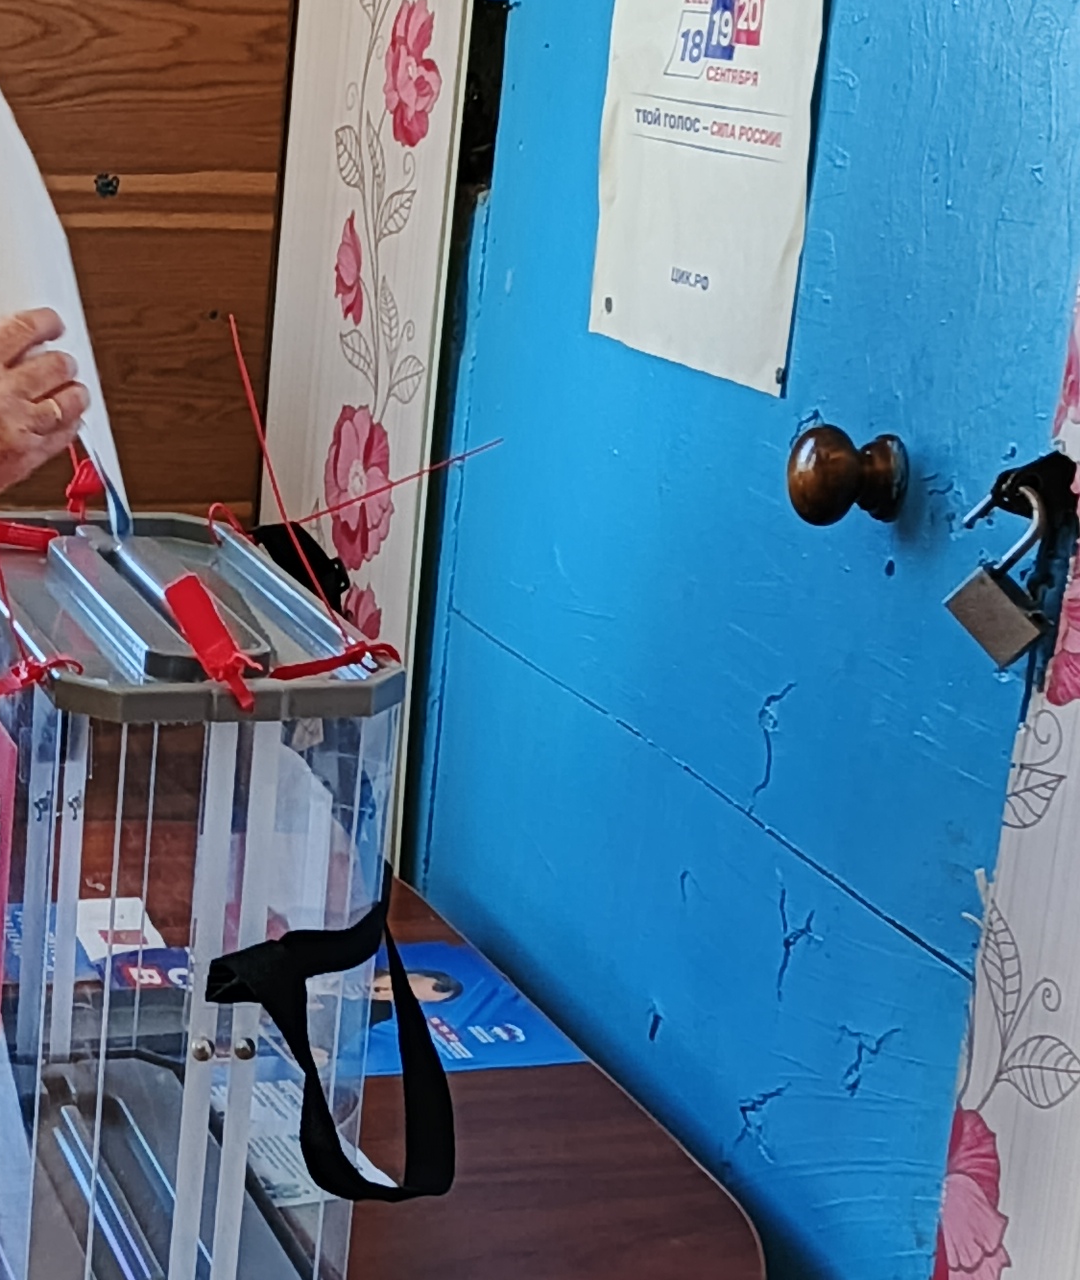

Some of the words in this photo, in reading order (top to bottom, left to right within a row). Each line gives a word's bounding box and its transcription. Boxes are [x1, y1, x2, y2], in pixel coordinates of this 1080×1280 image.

[680, 28, 704, 63] 18
[710, 7, 733, 47] 19
[706, 66, 758, 86] СЕНТЯБРЯ
[635, 107, 661, 126] ТВОЙ
[663, 113, 701, 133] ГОЛОС
[710, 120, 736, 140] СИЛА
